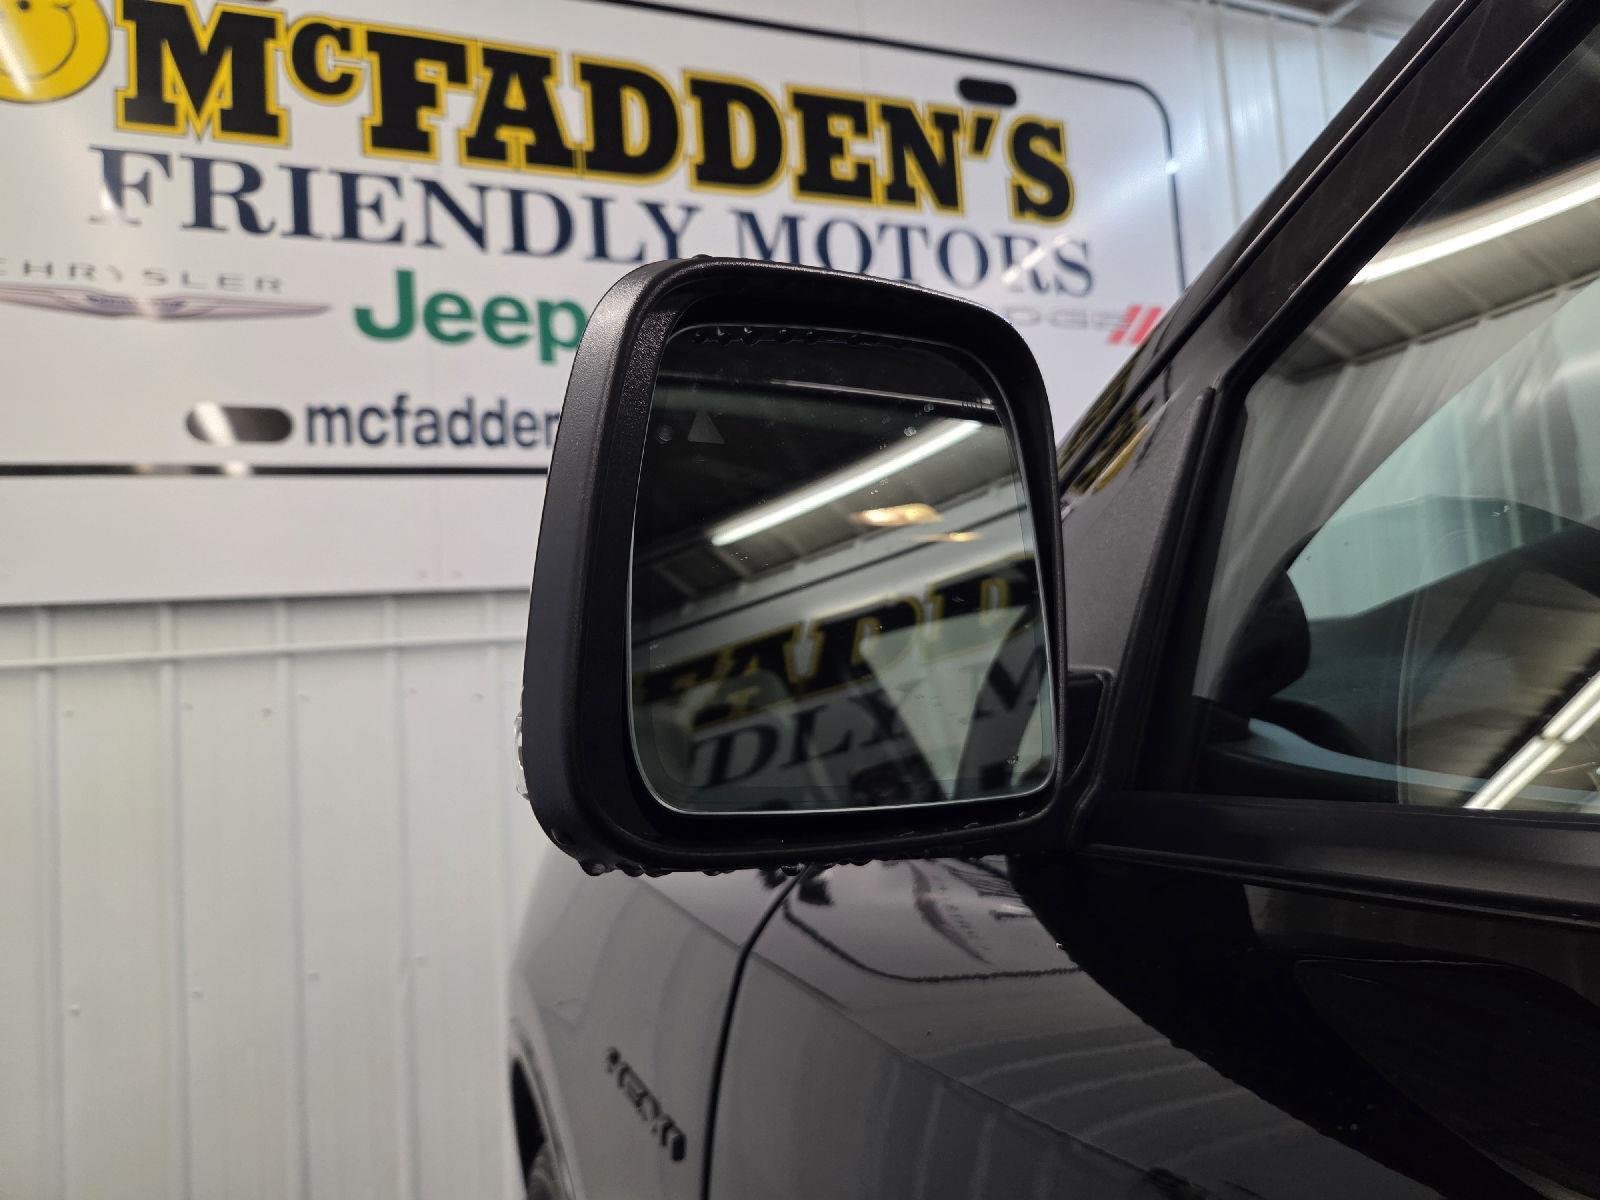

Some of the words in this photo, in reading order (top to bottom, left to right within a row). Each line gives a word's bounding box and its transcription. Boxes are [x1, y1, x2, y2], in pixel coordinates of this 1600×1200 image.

[90, 145, 702, 262] FRIENDLY
[730, 208, 1093, 298] MOTORS
[0, 257, 283, 291] HRSLER
[354, 268, 588, 363] Jeep
